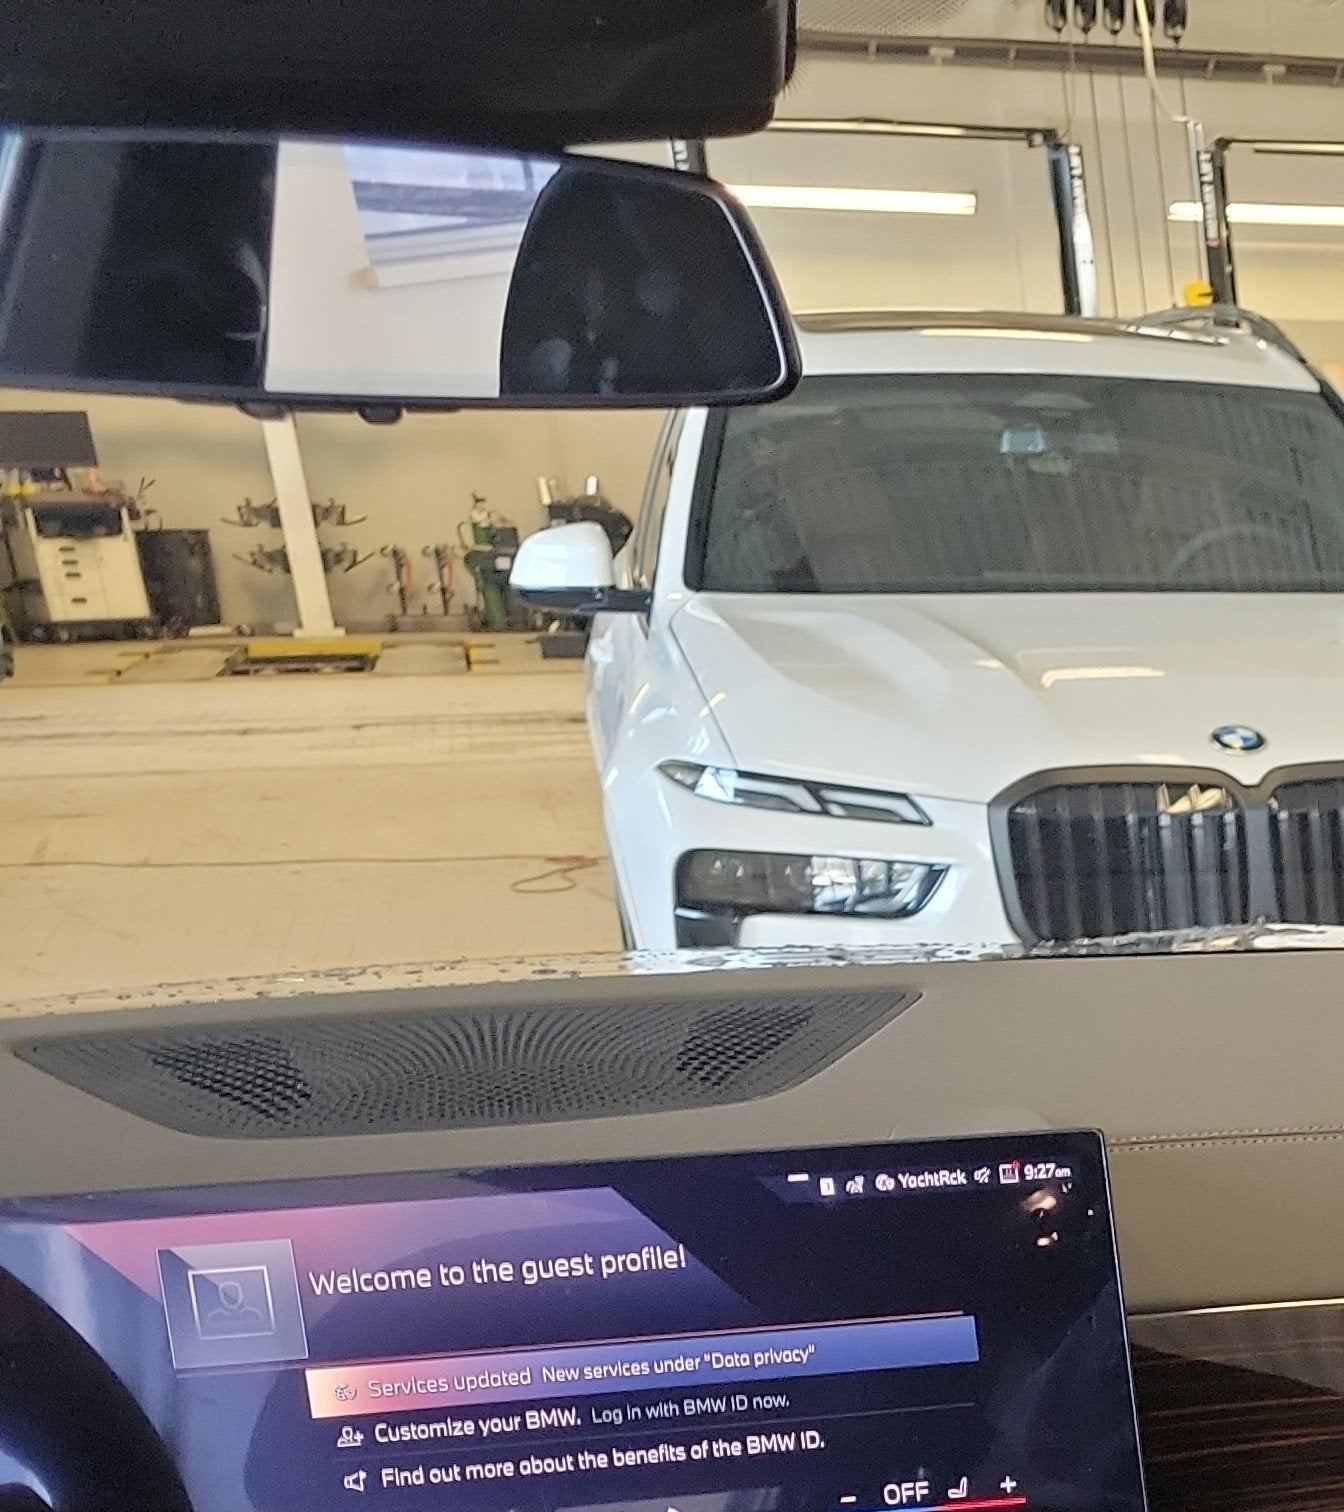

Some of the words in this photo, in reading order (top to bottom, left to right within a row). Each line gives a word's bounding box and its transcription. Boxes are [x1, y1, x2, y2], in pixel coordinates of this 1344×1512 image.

[898, 1169, 967, 1190] YachtRck
[309, 1267, 432, 1297] Welcome
[439, 1262, 466, 1287] to
[472, 1257, 515, 1284] the
[522, 1252, 595, 1286] guest
[601, 1243, 687, 1279] profile!
[367, 1376, 450, 1399] Services
[454, 1366, 533, 1392] updated
[542, 1363, 580, 1384] New
[583, 1359, 651, 1381] services
[653, 1355, 702, 1375] under
[703, 1350, 751, 1370] "Data
[754, 1343, 816, 1368] privacy"
[374, 1416, 476, 1444] Customize
[480, 1416, 522, 1440] your
[525, 1406, 583, 1431] BMW.
[591, 1406, 624, 1426] Log
[627, 1403, 642, 1421] in
[646, 1400, 680, 1419] with
[683, 1395, 727, 1416] BMW
[731, 1393, 748, 1412] ID
[752, 1393, 791, 1410] now.
[380, 1463, 426, 1489] Find
[429, 1461, 462, 1485] out
[465, 1460, 515, 1482] more
[520, 1453, 575, 1476] about
[578, 1449, 609, 1472] the
[612, 1441, 687, 1468] benefits
[690, 1439, 709, 1460] of
[709, 1437, 743, 1459] the
[746, 1431, 796, 1456] BMW
[799, 1429, 826, 1451] ID.
[883, 1480, 930, 1506] OFF
